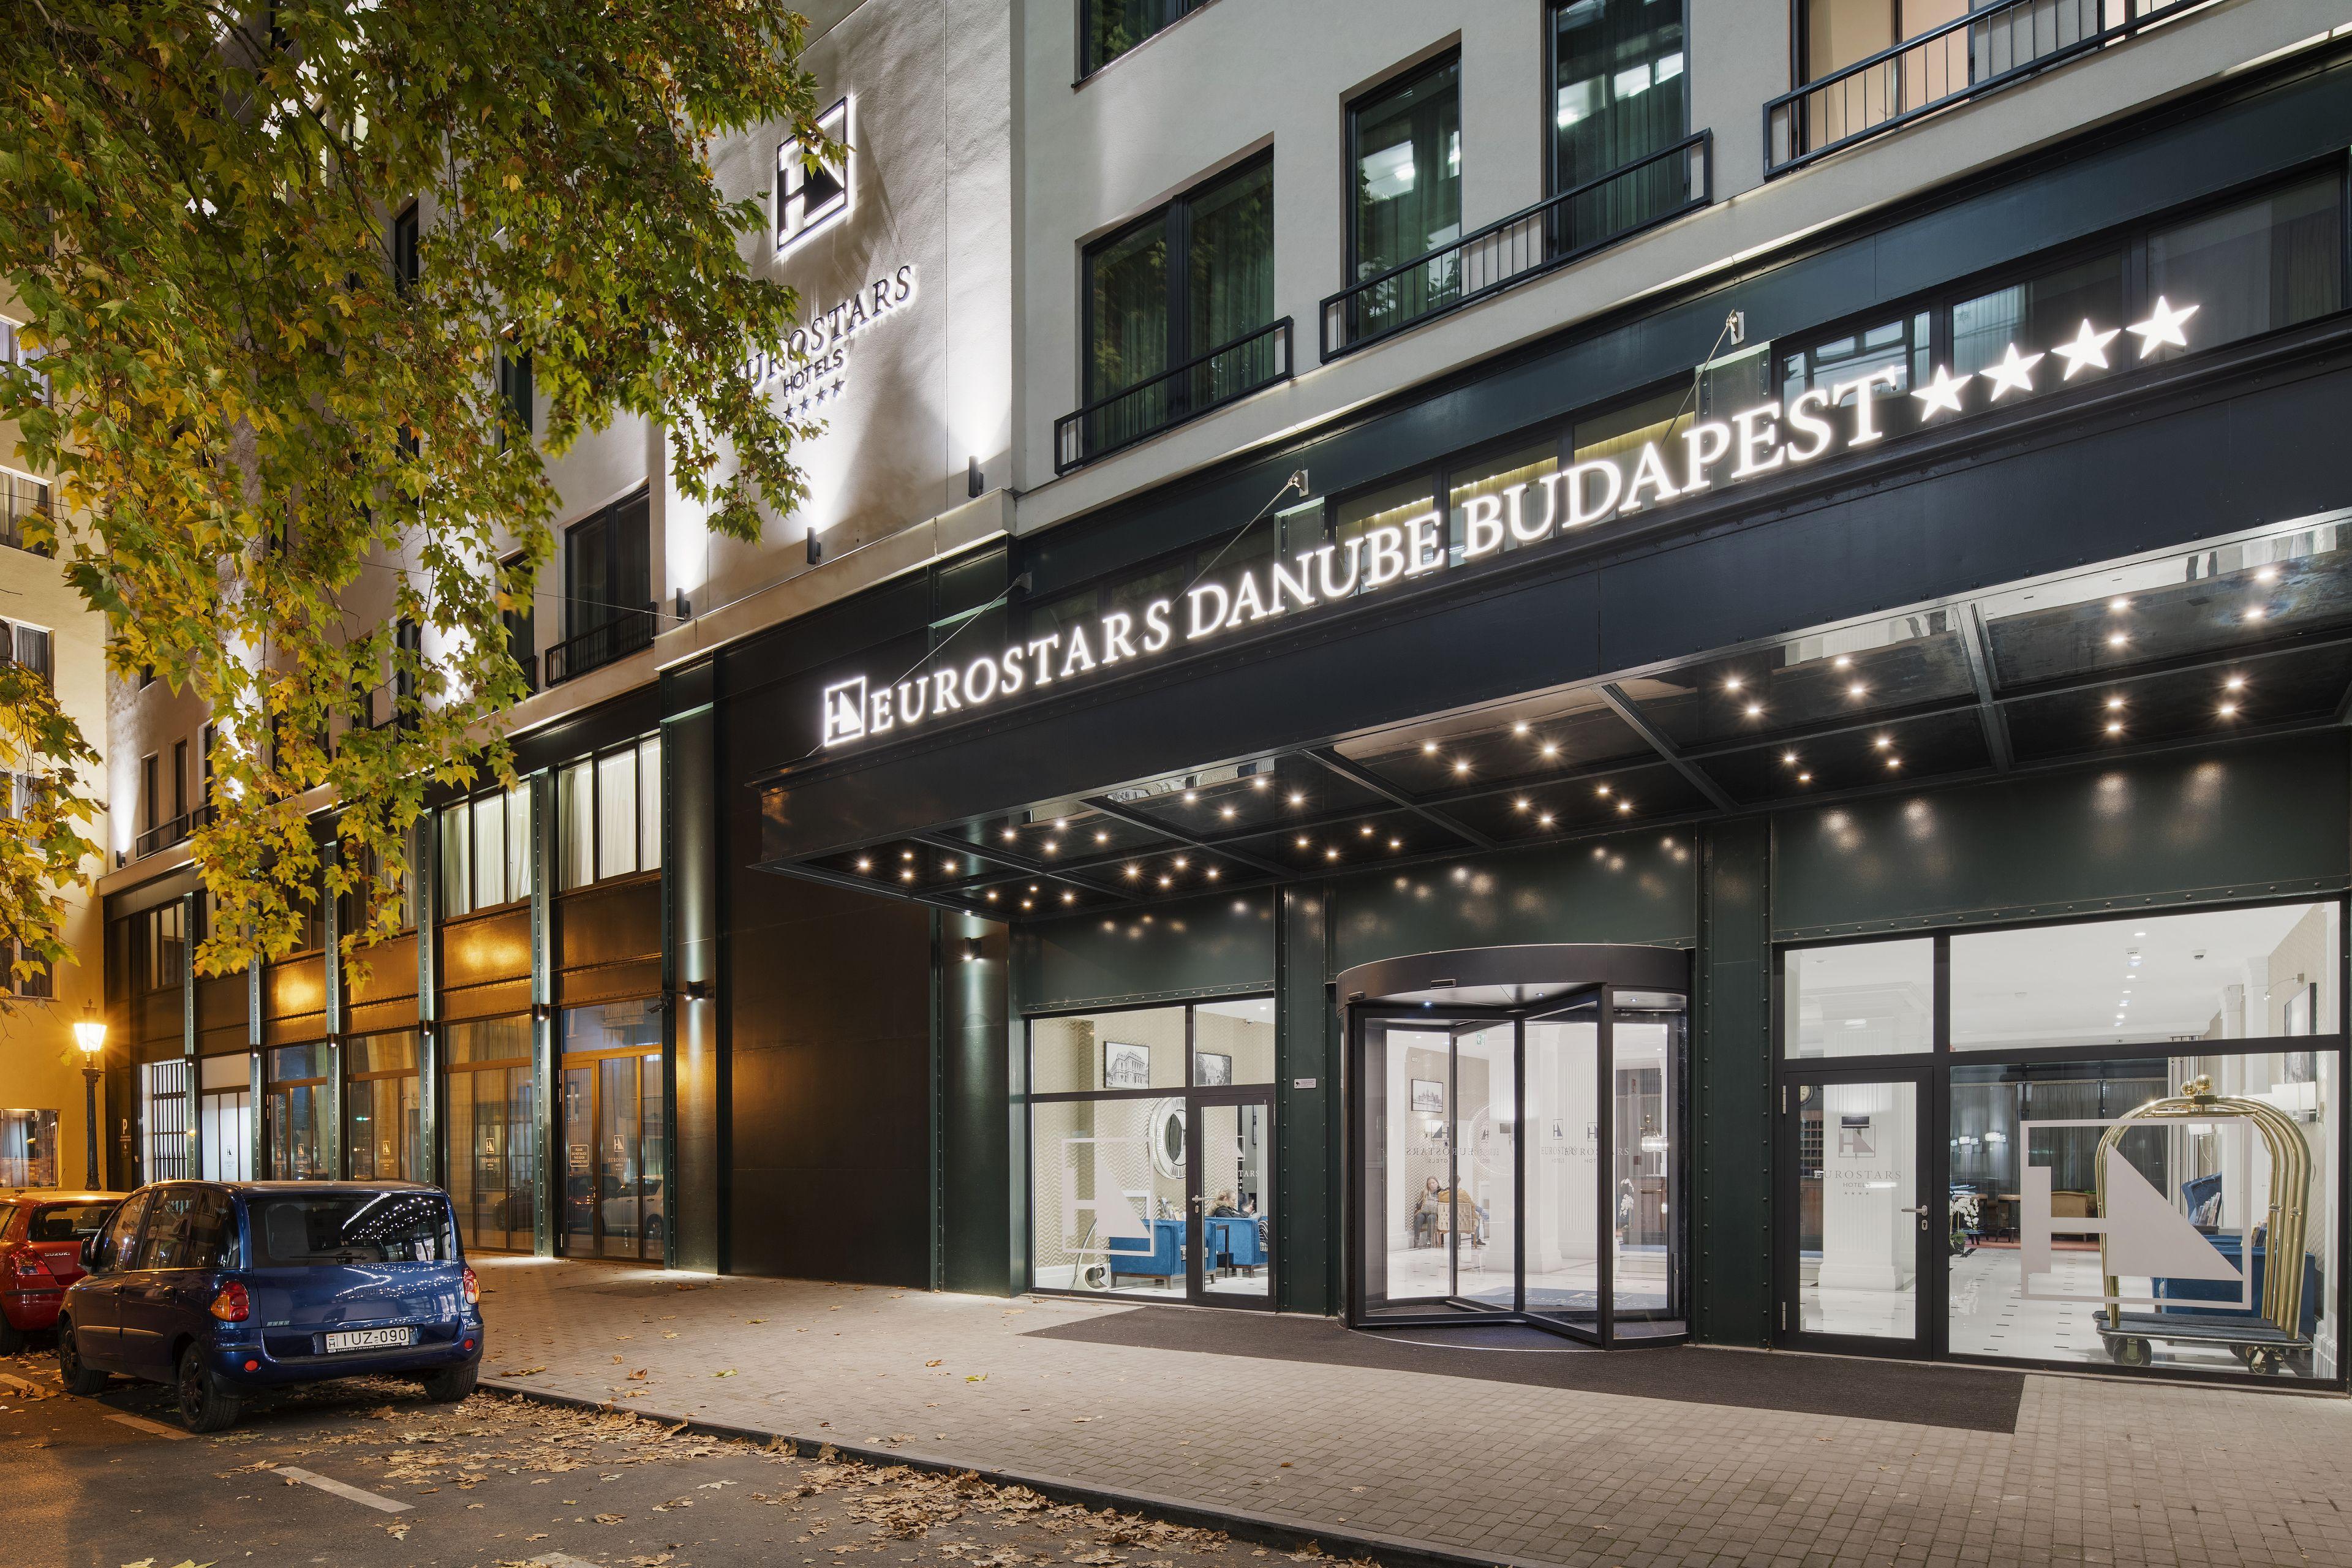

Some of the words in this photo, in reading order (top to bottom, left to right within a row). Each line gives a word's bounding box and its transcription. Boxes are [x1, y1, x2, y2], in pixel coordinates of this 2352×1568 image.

[783, 348, 845, 398] HOTELS
[869, 600, 1170, 734] EUROSTARS
[1186, 511, 1444, 640] DANUBE
[1461, 365, 1897, 559] BUDAPEST
[123, 1118, 127, 1134] P
[1814, 1170, 1902, 1179] EUROSTARS
[344, 1329, 406, 1346] IUZ-090
